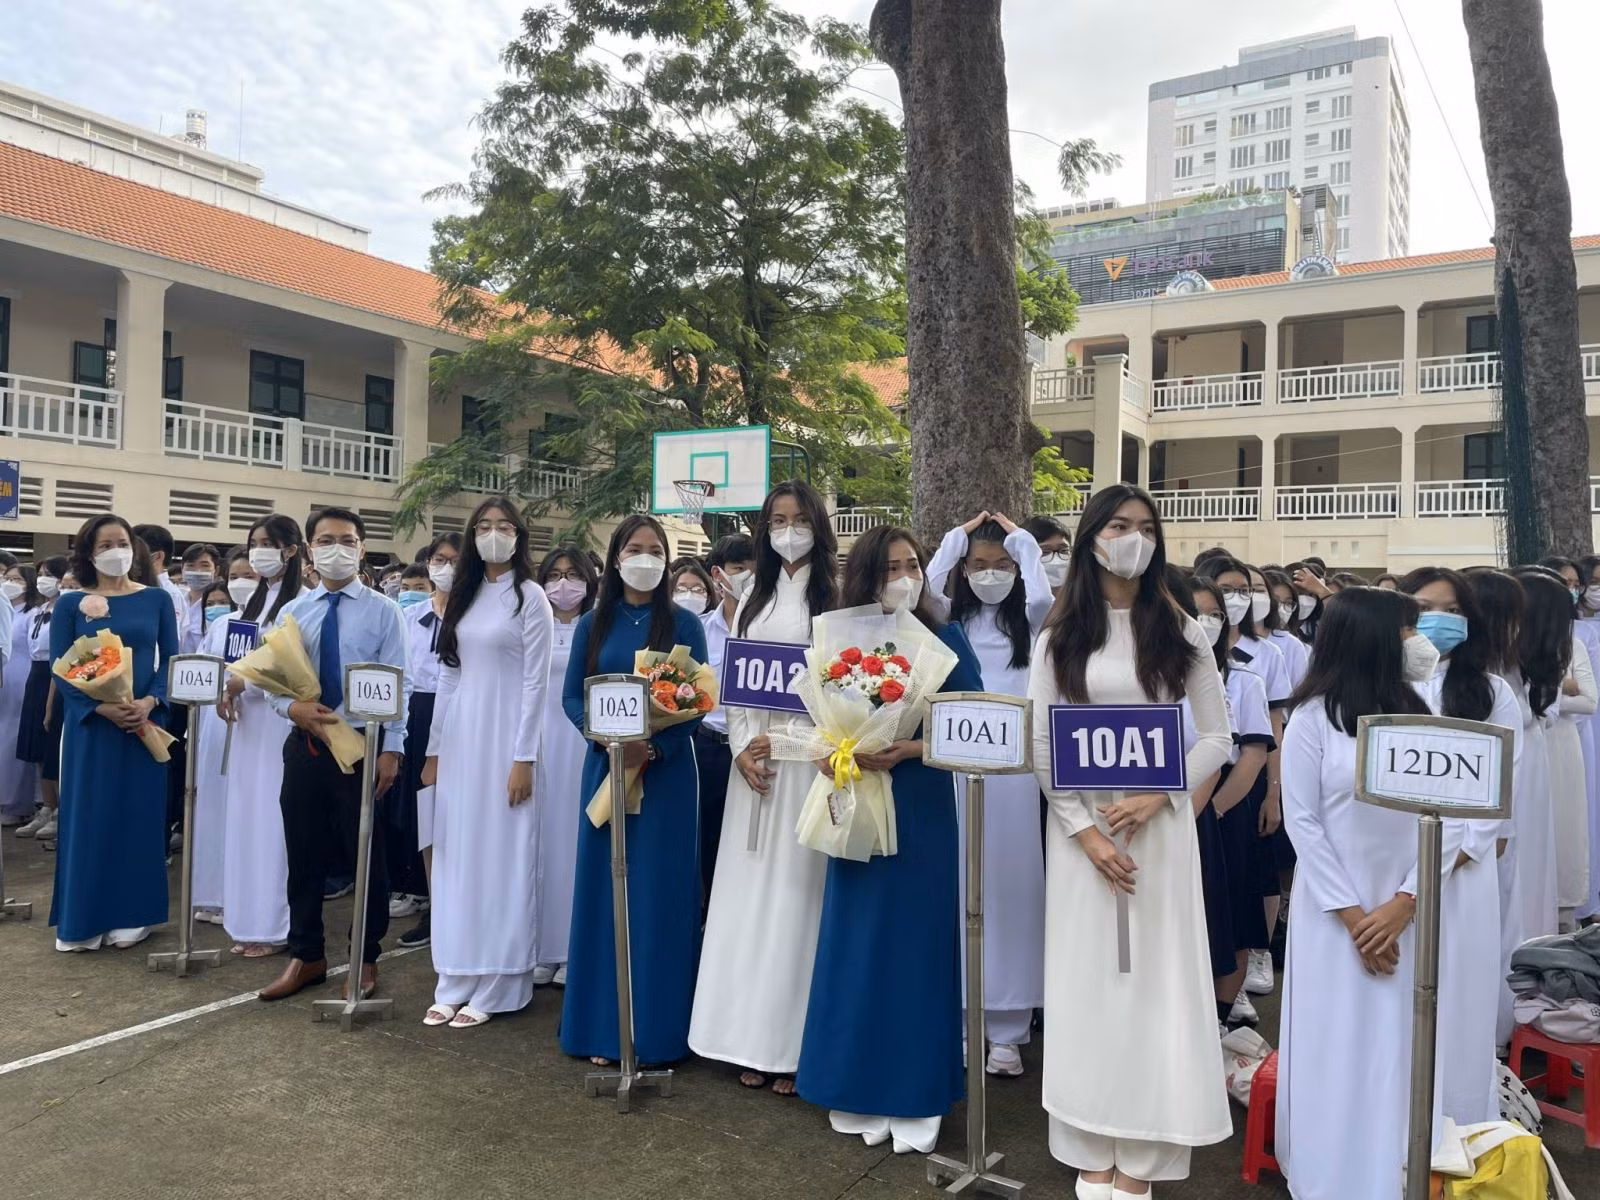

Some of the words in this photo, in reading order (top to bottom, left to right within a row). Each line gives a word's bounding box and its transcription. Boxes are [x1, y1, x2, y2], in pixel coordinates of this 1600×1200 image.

[178, 669, 213, 687] 10A4
[356, 680, 392, 701] 10A3
[599, 695, 638, 718] 10A2
[946, 717, 1009, 746] 10A1
[1071, 726, 1165, 768] 10A1
[1387, 747, 1484, 782] 12DN
